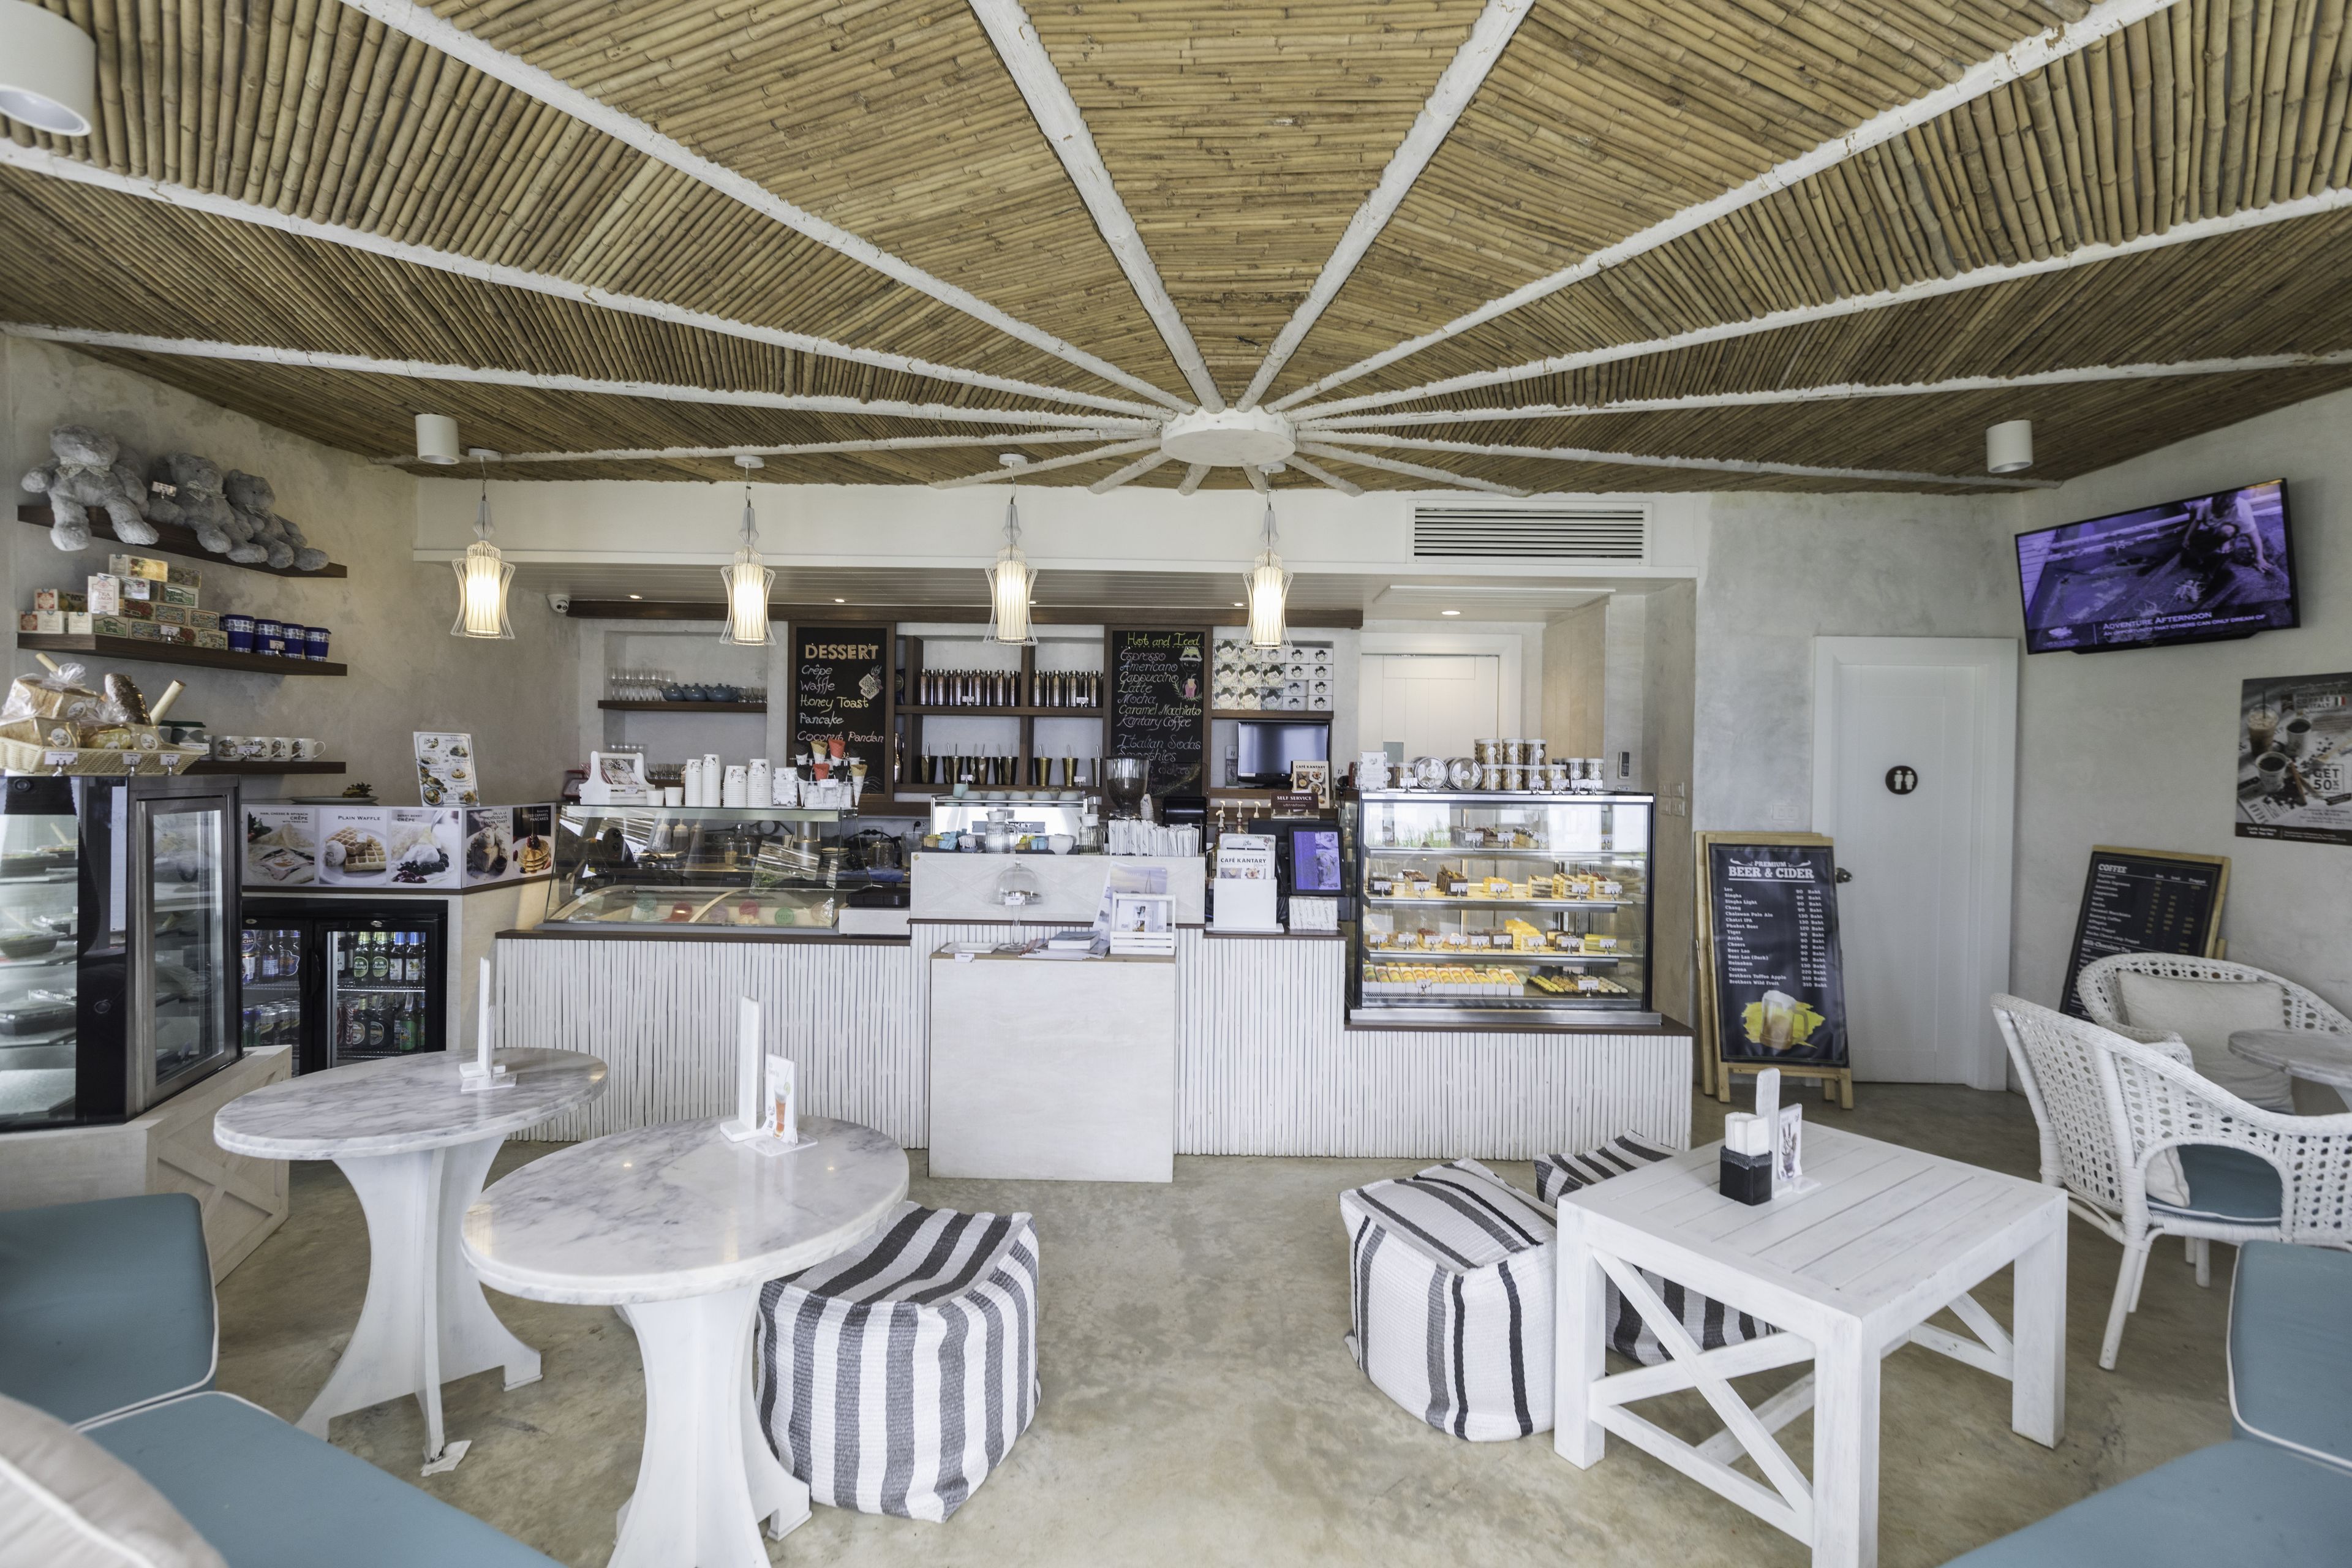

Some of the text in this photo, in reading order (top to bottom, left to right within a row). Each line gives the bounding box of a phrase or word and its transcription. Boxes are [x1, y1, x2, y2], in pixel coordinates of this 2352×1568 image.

[2103, 612, 2212, 630] ADVENTURE AFTERNOON
[1128, 632, 1200, 647] Hot and Iced
[805, 643, 879, 660] DESSERT
[1120, 649, 1166, 662] Espresso
[801, 664, 833, 679] Crêpe
[1120, 661, 1178, 673] Americano
[1120, 671, 1179, 685] Cappuccino
[800, 676, 835, 695] Waffle
[1118, 680, 1153, 693] Latte
[800, 695, 869, 714] Honey Toast
[1117, 693, 1156, 704] Mocha
[1118, 703, 1202, 716] Caramel Macchiato
[799, 711, 844, 727] Pancake
[1117, 714, 1191, 731] Kantary Coffee
[848, 731, 883, 743] Pandan
[1117, 733, 1201, 750] Italian Sodas
[2314, 768, 2340, 778] GET
[1728, 866, 1815, 879] BEER & CIDER
[2098, 864, 2128, 873] COFFEE
